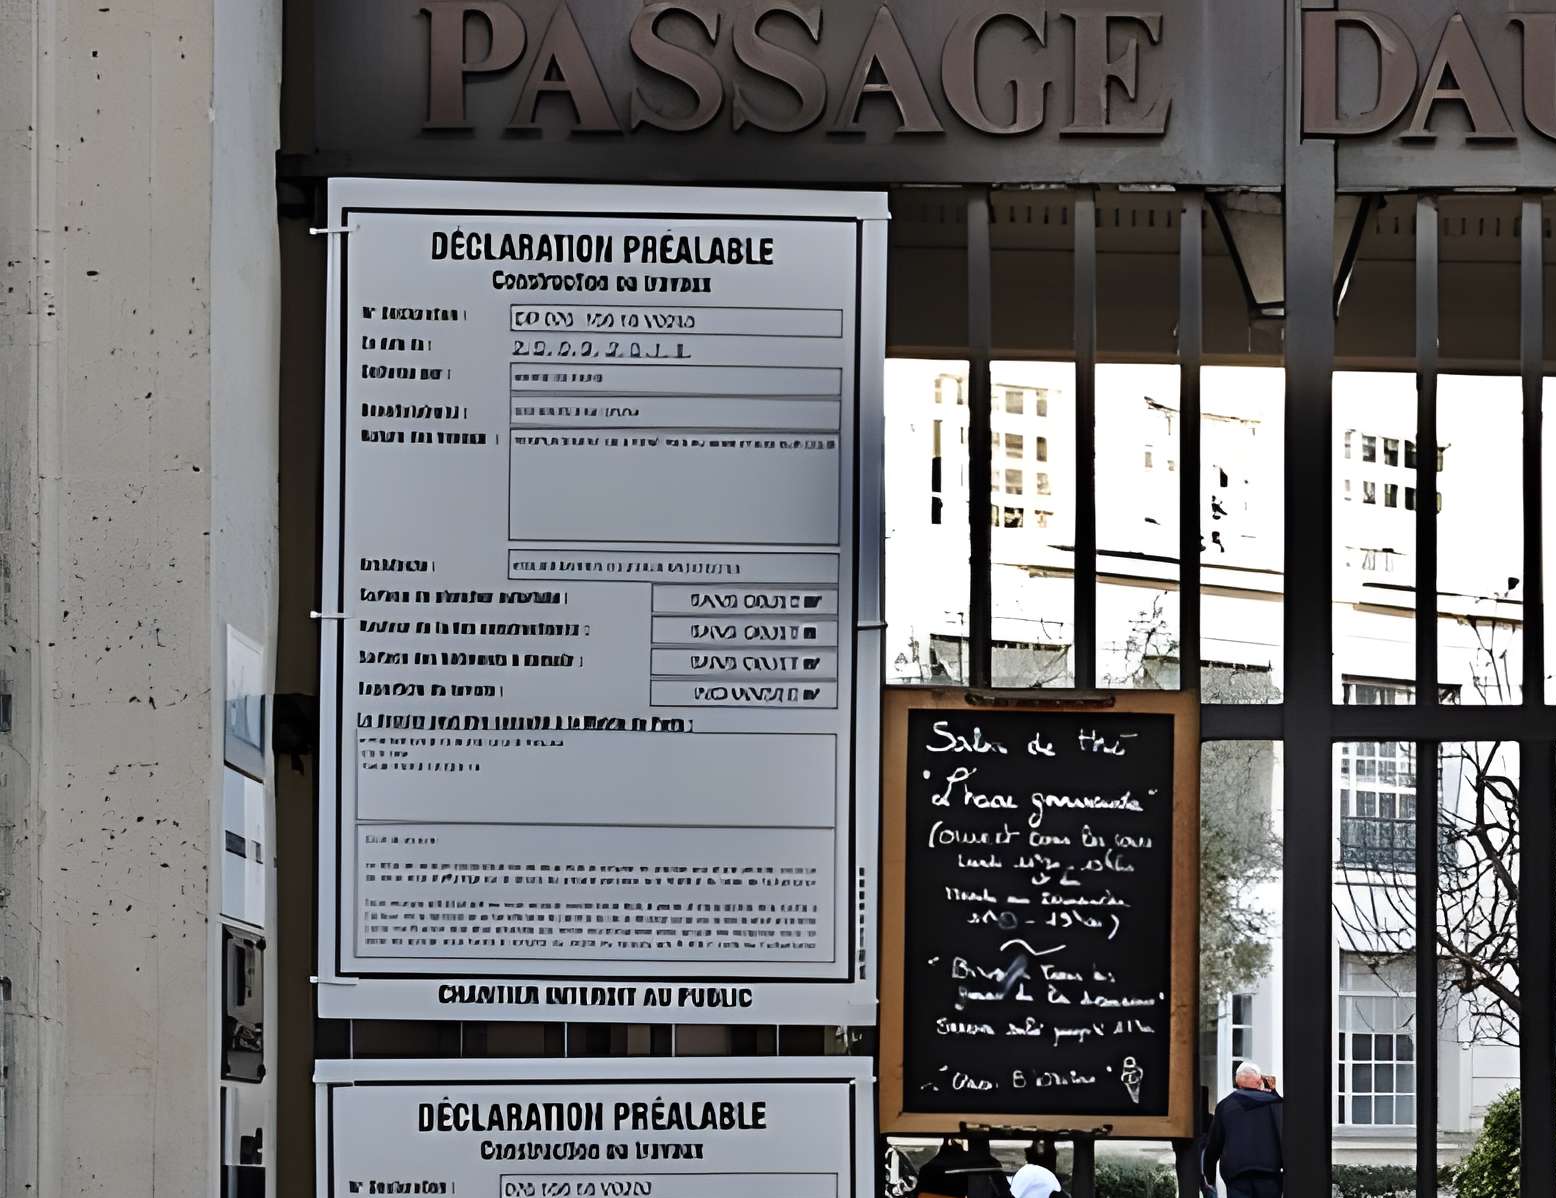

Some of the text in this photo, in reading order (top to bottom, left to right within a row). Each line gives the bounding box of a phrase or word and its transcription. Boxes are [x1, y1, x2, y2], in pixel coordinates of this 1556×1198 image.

[420, 3, 1173, 139] PASSAGE
[431, 227, 775, 266] DÉCLARATION PRÉALABLE
[417, 1096, 768, 1132] DÉCLARATION PRÉALABLE
